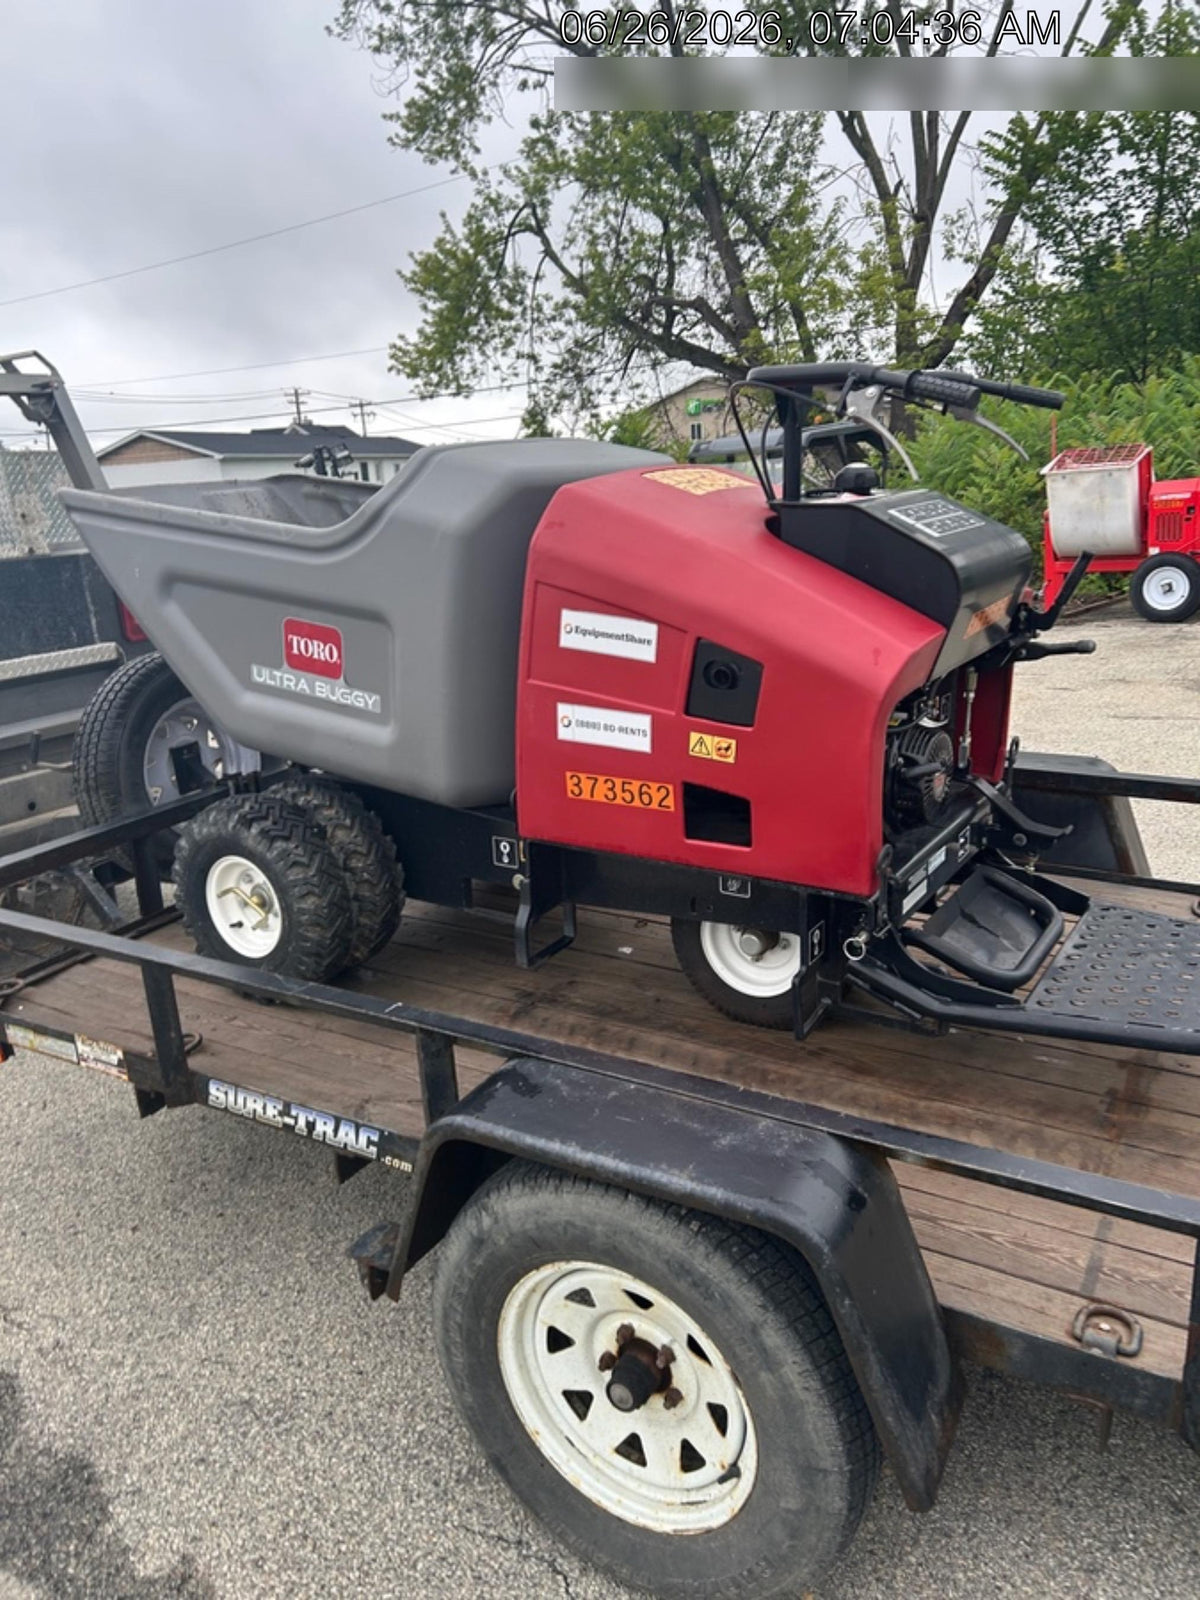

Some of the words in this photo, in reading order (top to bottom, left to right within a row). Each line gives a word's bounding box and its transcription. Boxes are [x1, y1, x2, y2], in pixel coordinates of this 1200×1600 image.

[574, 625, 653, 646] EquipmentShare
[252, 665, 310, 694] ULTRA
[315, 681, 377, 710] BUGGY
[569, 774, 672, 810] 373562
[208, 1079, 379, 1159] SURE-TRAC
